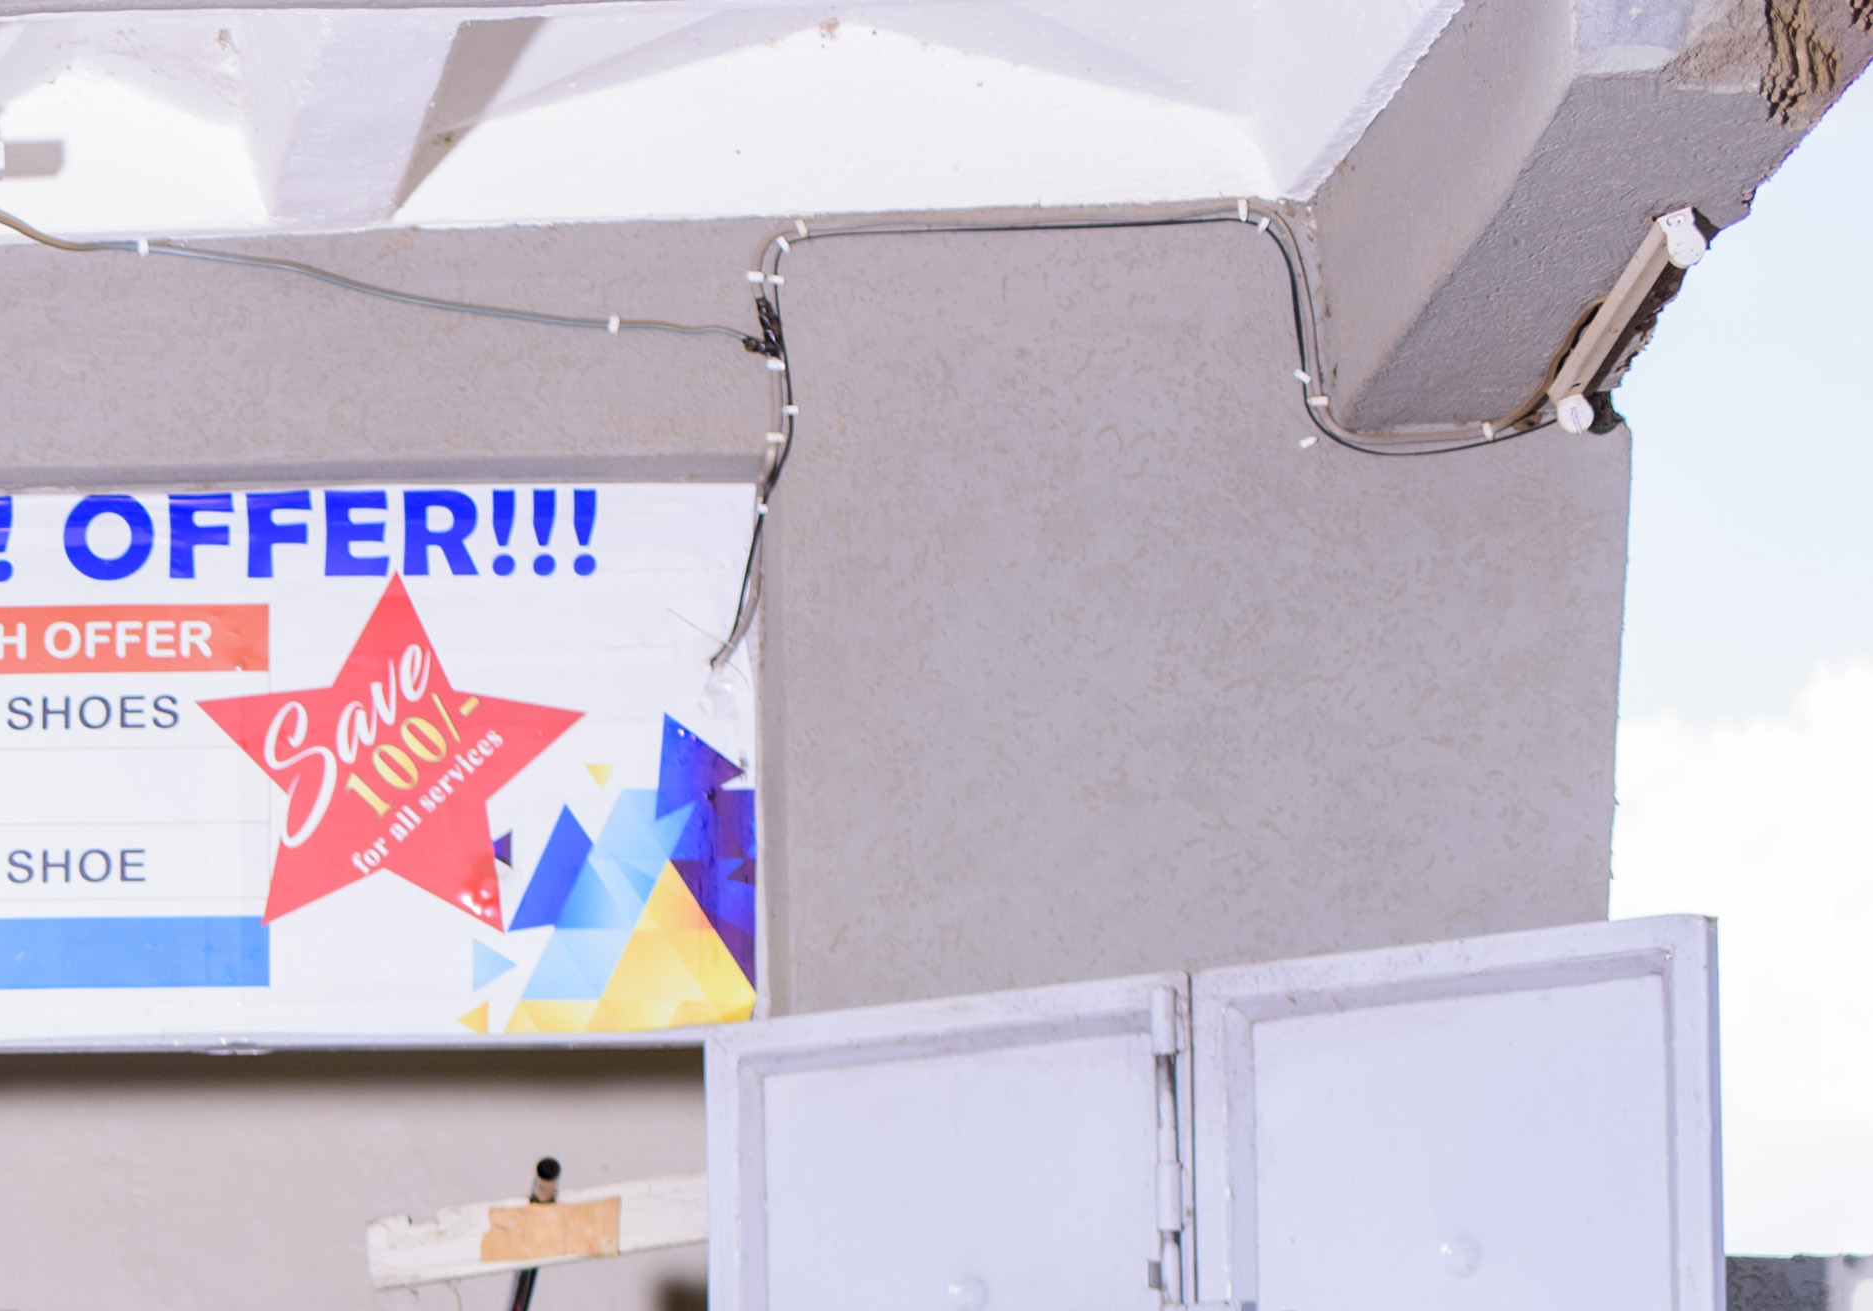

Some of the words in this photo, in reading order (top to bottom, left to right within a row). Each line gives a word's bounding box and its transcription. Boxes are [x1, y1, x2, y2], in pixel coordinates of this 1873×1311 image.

[63, 488, 598, 581] OFFER!!!
[44, 620, 213, 660] OFFER
[7, 695, 181, 731] SHOES
[263, 644, 431, 848] Save
[345, 693, 480, 820] 100/-
[351, 837, 389, 874] for
[390, 805, 422, 841] all
[419, 730, 503, 813] services
[7, 849, 146, 884] SHOE
